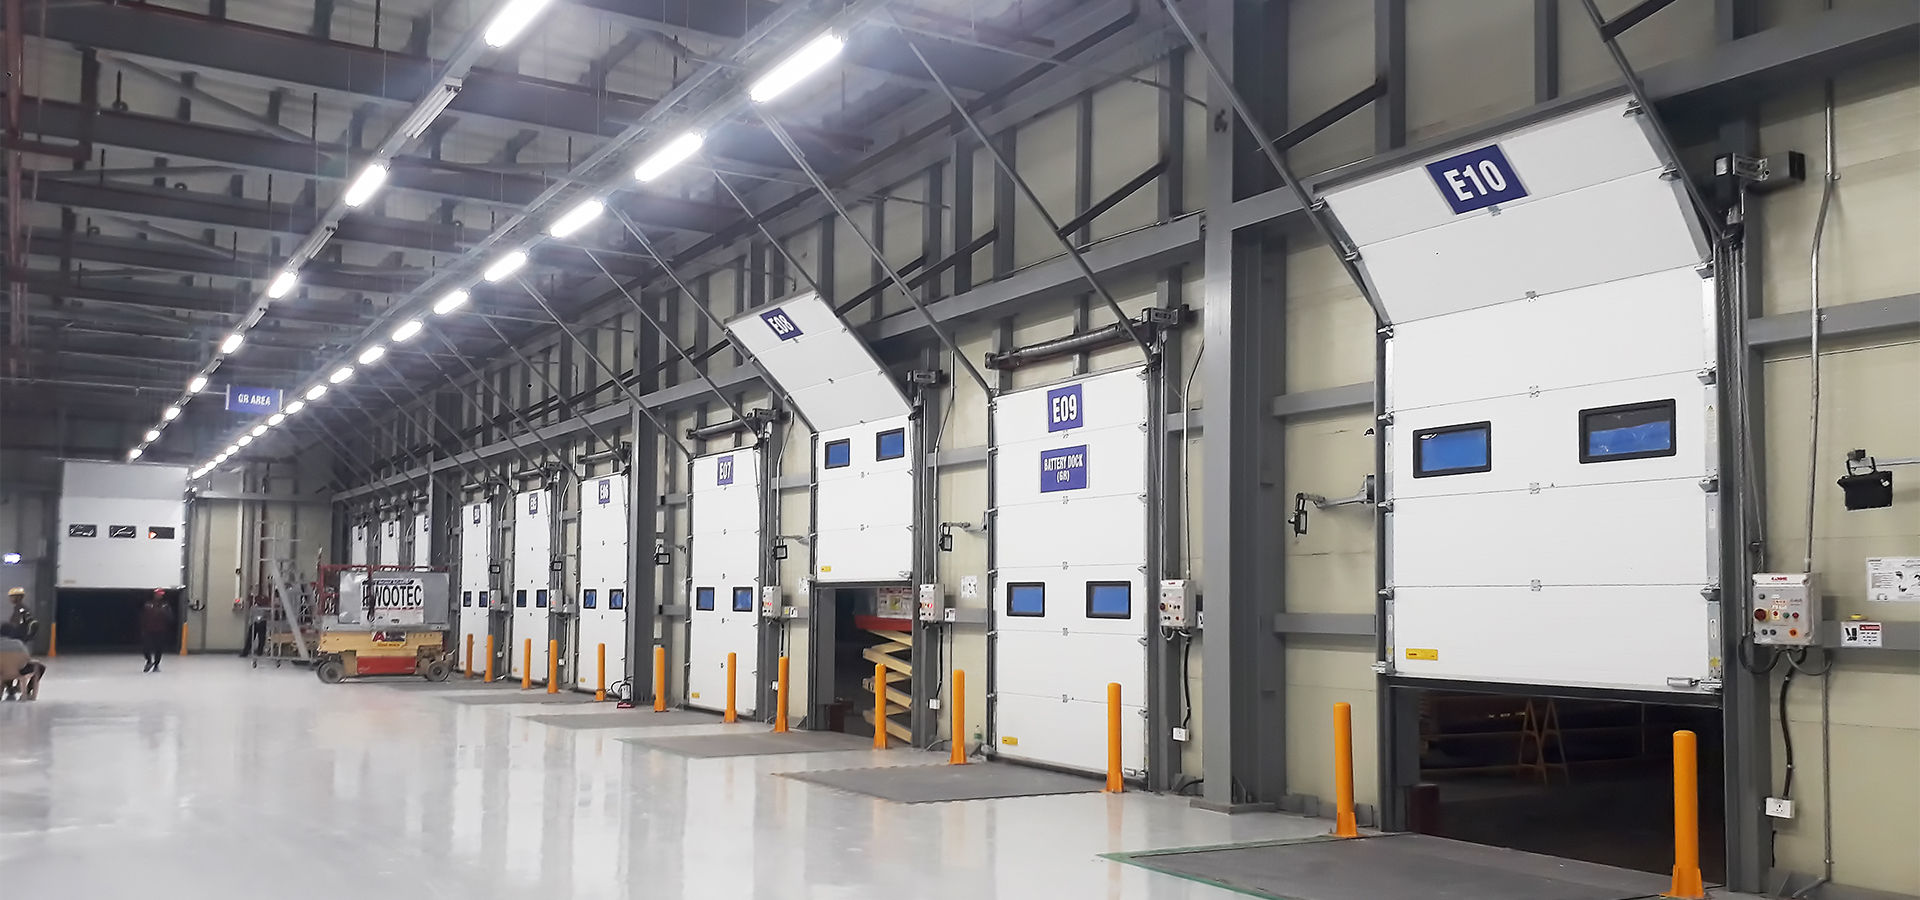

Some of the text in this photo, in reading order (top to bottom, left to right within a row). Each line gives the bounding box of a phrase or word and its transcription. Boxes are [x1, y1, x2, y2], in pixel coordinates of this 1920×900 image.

[1443, 159, 1507, 202] E10
[767, 314, 795, 335] E08
[250, 395, 271, 406] AREA
[1052, 394, 1078, 424] E09
[719, 461, 731, 480] E07
[1044, 453, 1083, 472] BATTERY DOCK
